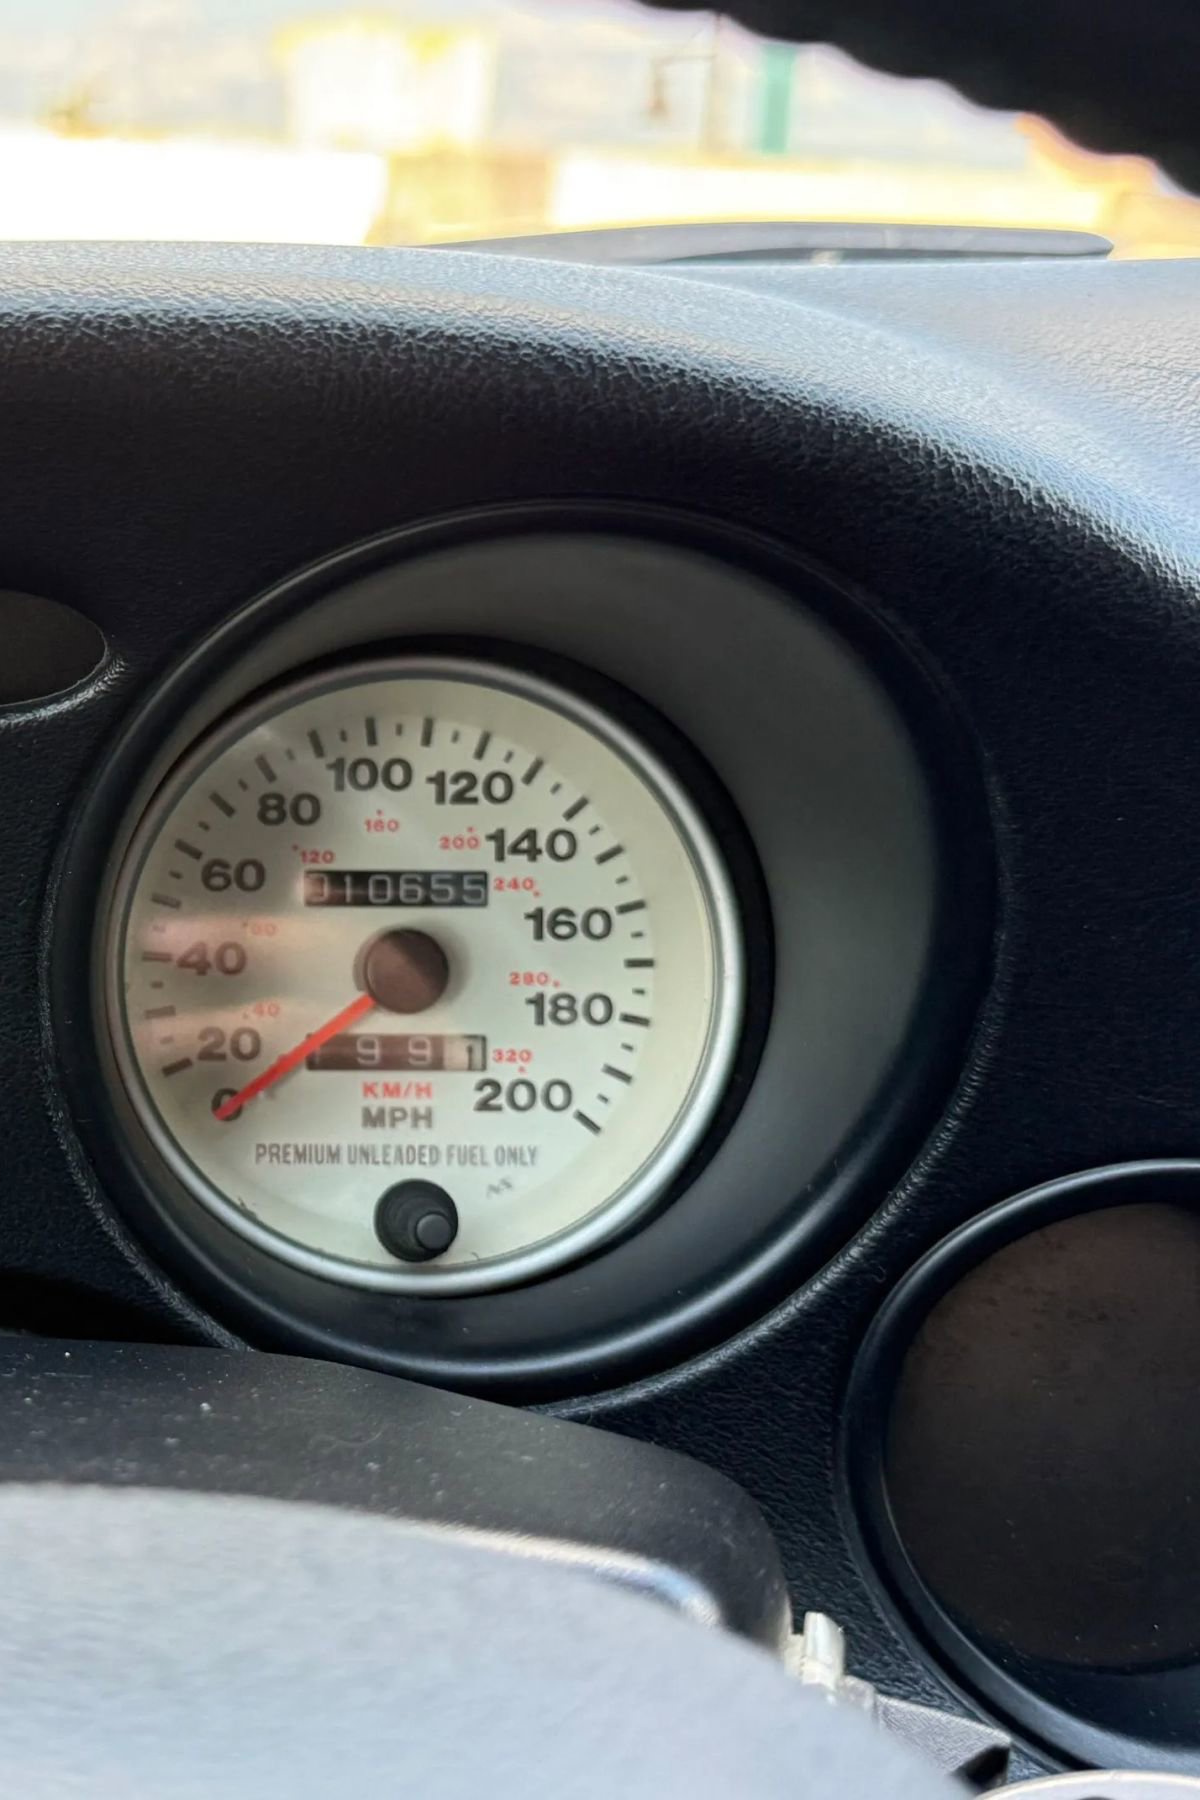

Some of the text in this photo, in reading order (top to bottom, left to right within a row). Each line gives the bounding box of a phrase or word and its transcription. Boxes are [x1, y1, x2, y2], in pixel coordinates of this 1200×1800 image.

[326, 757, 413, 792] 100
[426, 770, 514, 805] 120
[257, 793, 321, 826] 80
[364, 818, 399, 833] 160
[300, 850, 334, 864] 120
[439, 835, 480, 850] 200
[486, 828, 577, 862] 140
[201, 858, 265, 892] 60
[494, 877, 534, 891] 240
[524, 907, 612, 941] 160
[176, 941, 247, 976] 40
[509, 972, 549, 985] 280
[525, 992, 614, 1026] 180
[197, 1027, 261, 1061] 20
[493, 1049, 532, 1063] 320
[362, 1082, 433, 1098] KM/H
[473, 1078, 573, 1112] 200
[362, 1108, 433, 1128] MPH
[255, 1144, 538, 1166] PREMIUM UNLEADED FUEL ONLY
